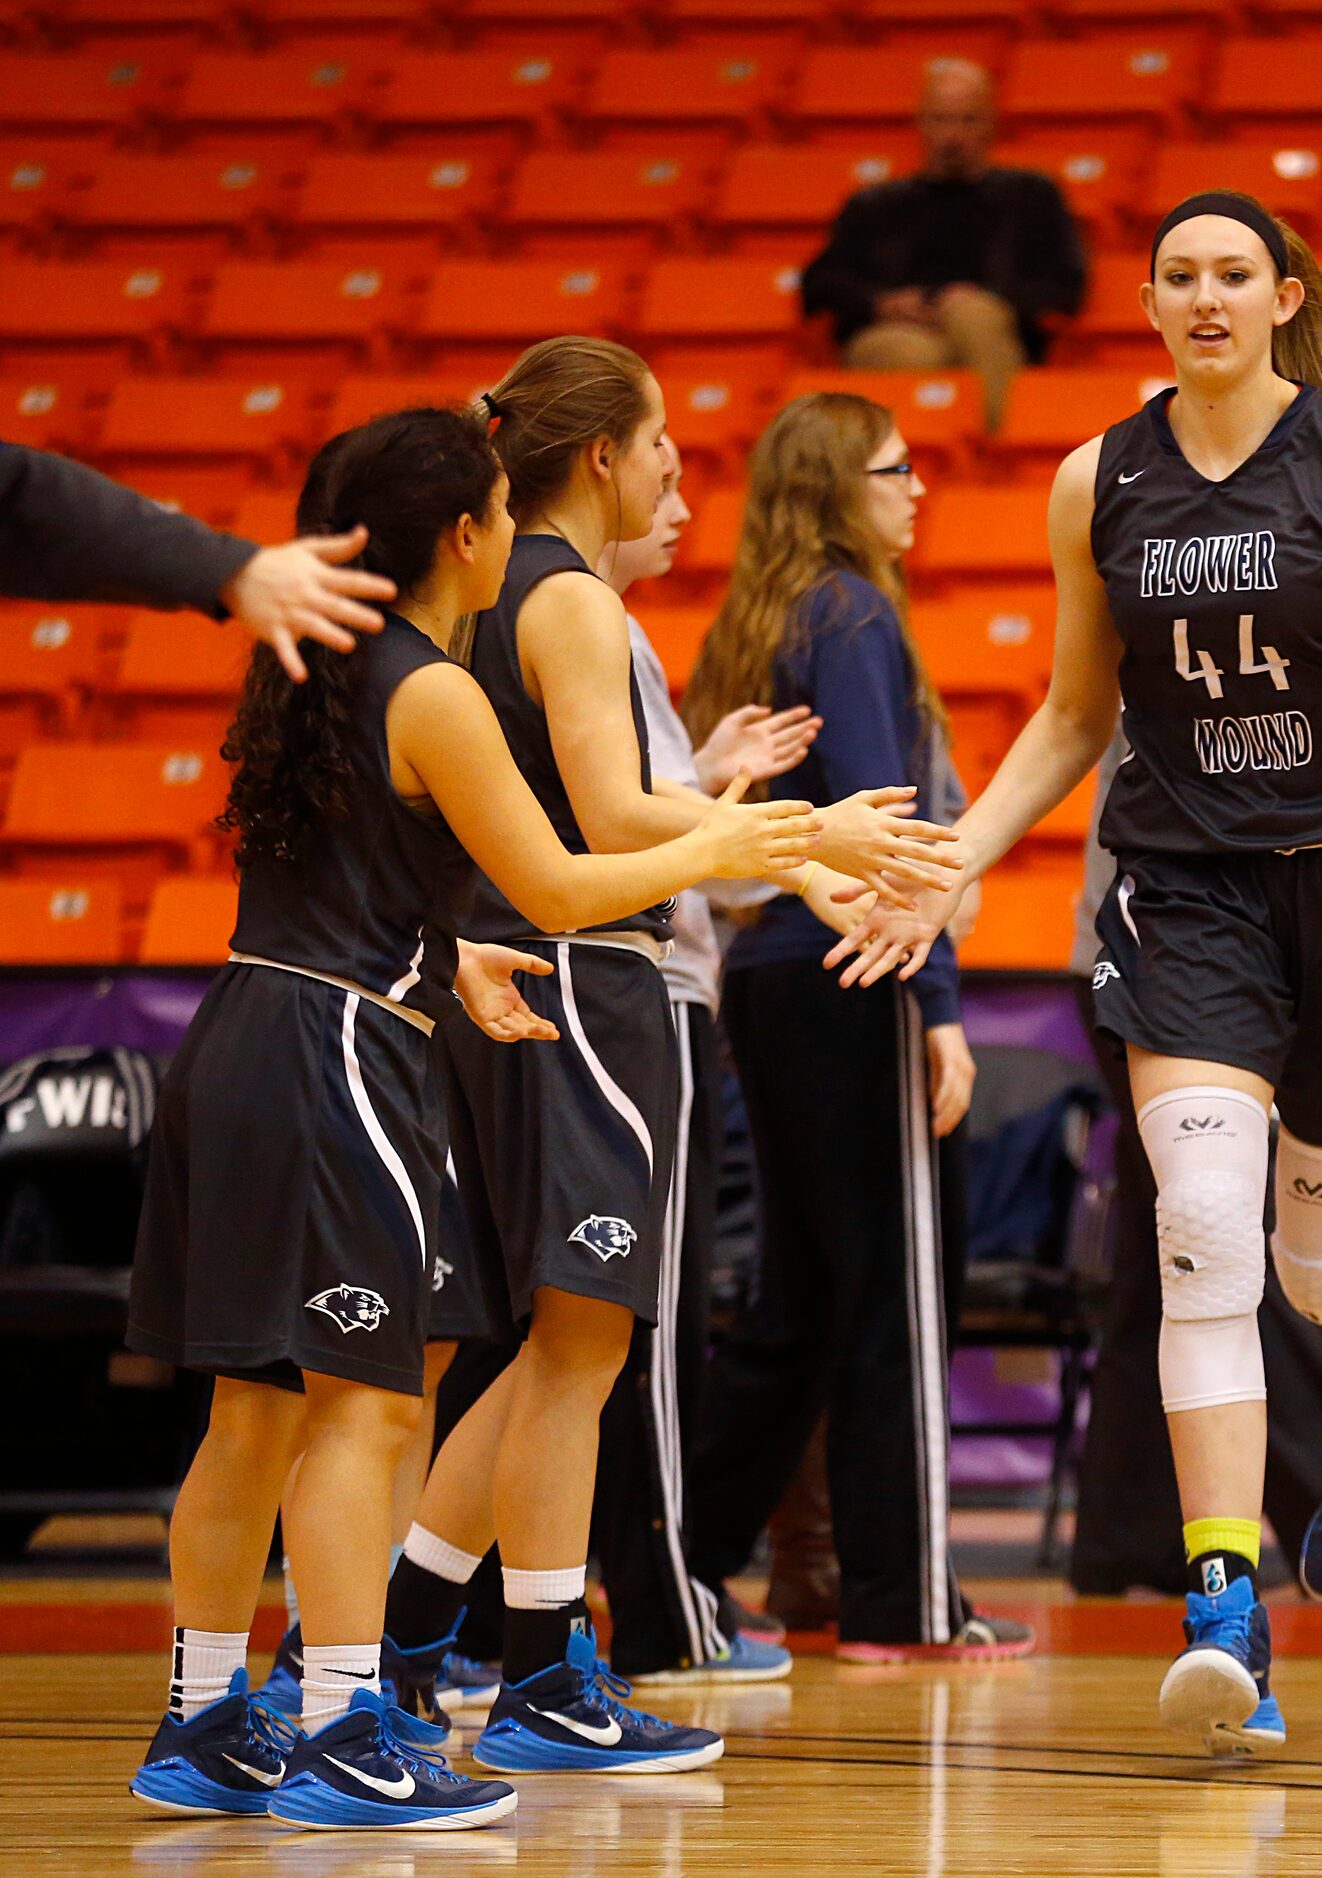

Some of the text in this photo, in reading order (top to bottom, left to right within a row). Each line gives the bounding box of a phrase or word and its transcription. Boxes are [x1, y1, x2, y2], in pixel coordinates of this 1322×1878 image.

[1140, 530, 1278, 598] FLOWER
[1173, 614, 1291, 699] 44
[1194, 710, 1313, 774] MOUND
